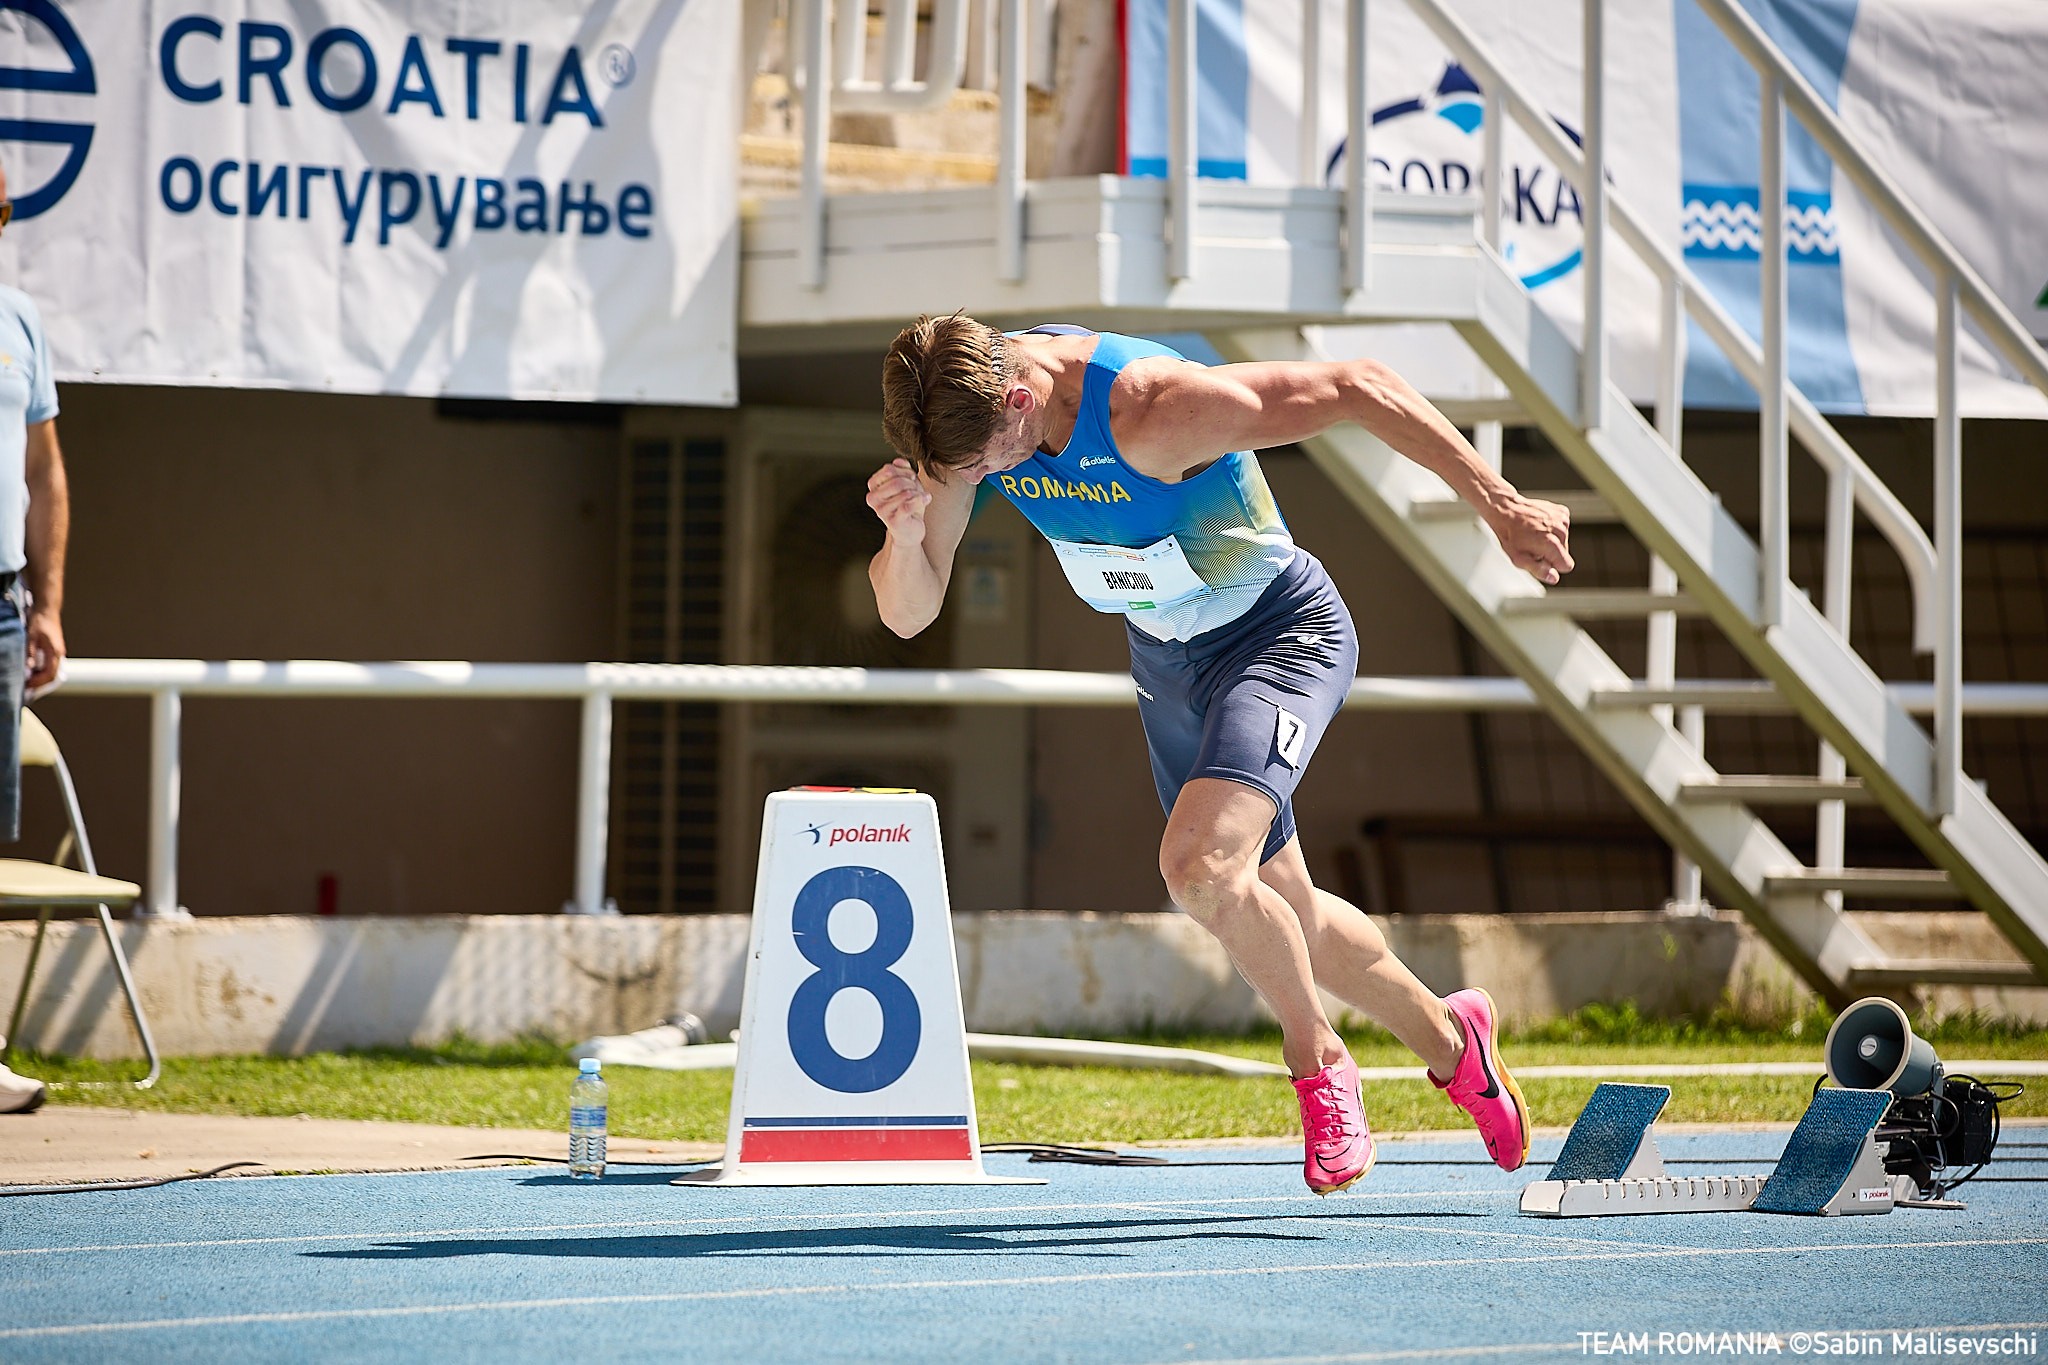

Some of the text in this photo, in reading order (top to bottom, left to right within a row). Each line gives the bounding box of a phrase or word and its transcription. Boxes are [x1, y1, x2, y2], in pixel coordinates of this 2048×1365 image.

[159, 16, 605, 128] CROATIA
[160, 155, 655, 249] осигурување
[1365, 158, 1584, 225] ORKA
[1000, 475, 1132, 504] ROMANIA
[1283, 720, 1299, 753] 7
[829, 823, 912, 847] polanik
[787, 866, 921, 1093] 8
